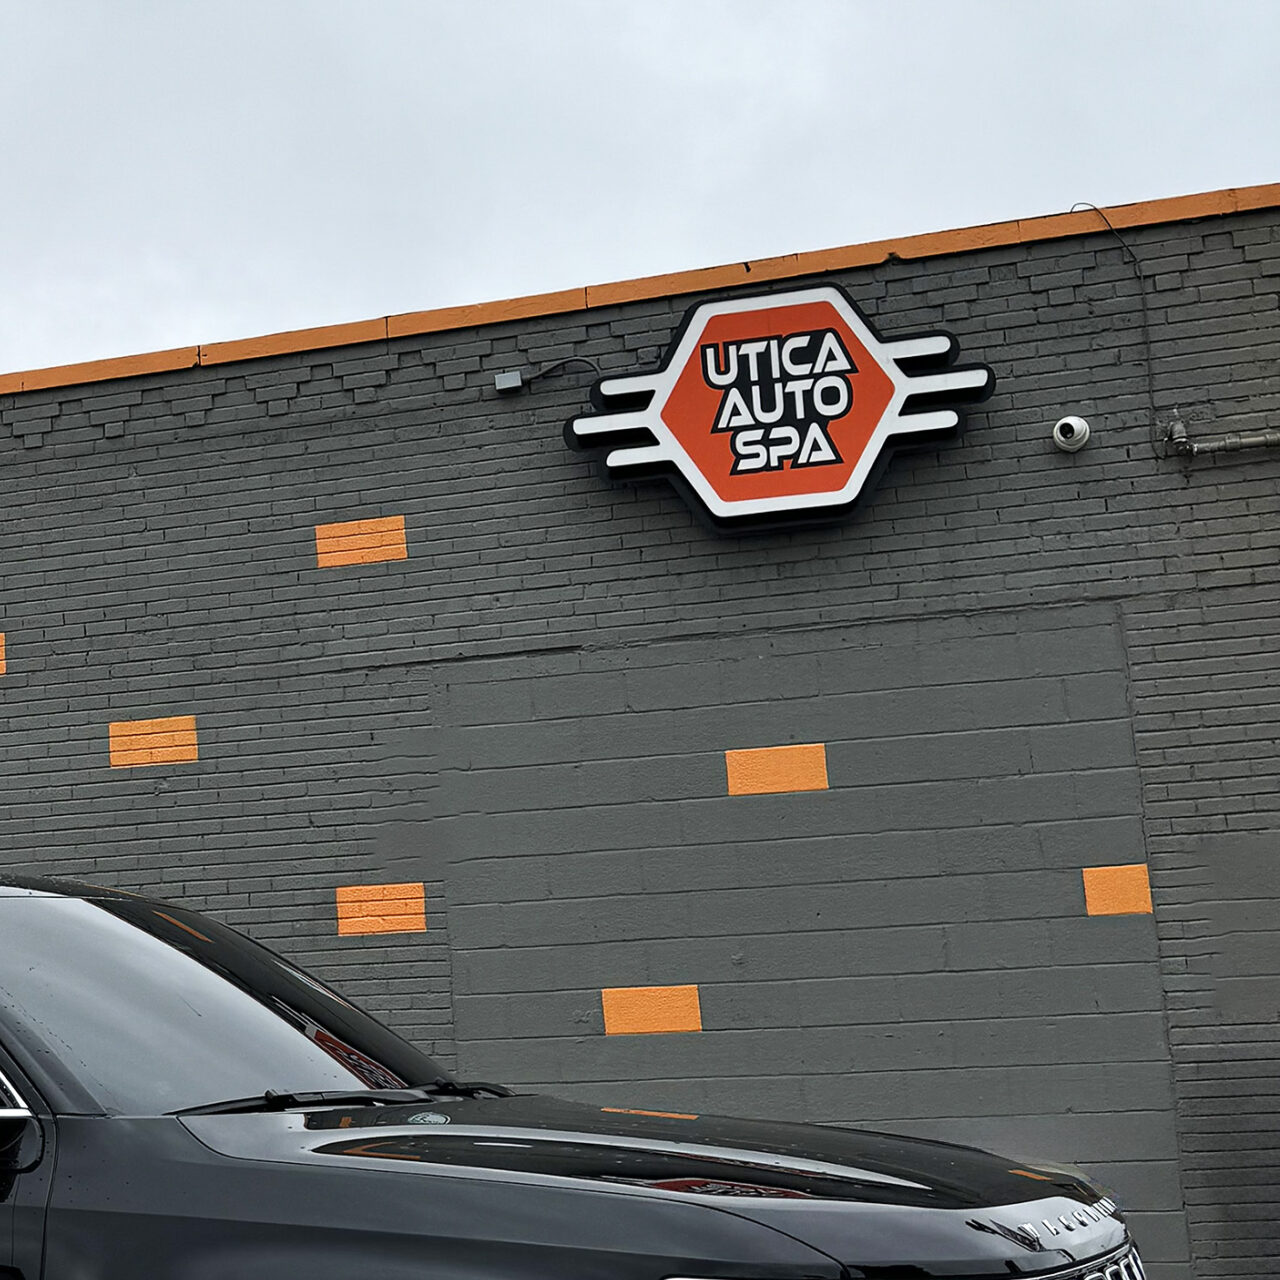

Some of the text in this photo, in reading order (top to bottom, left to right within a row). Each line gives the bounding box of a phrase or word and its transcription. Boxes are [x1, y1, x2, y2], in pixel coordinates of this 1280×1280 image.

[704, 331, 853, 386] UTICA
[717, 375, 850, 429] AUTO
[736, 422, 837, 471] SPA
